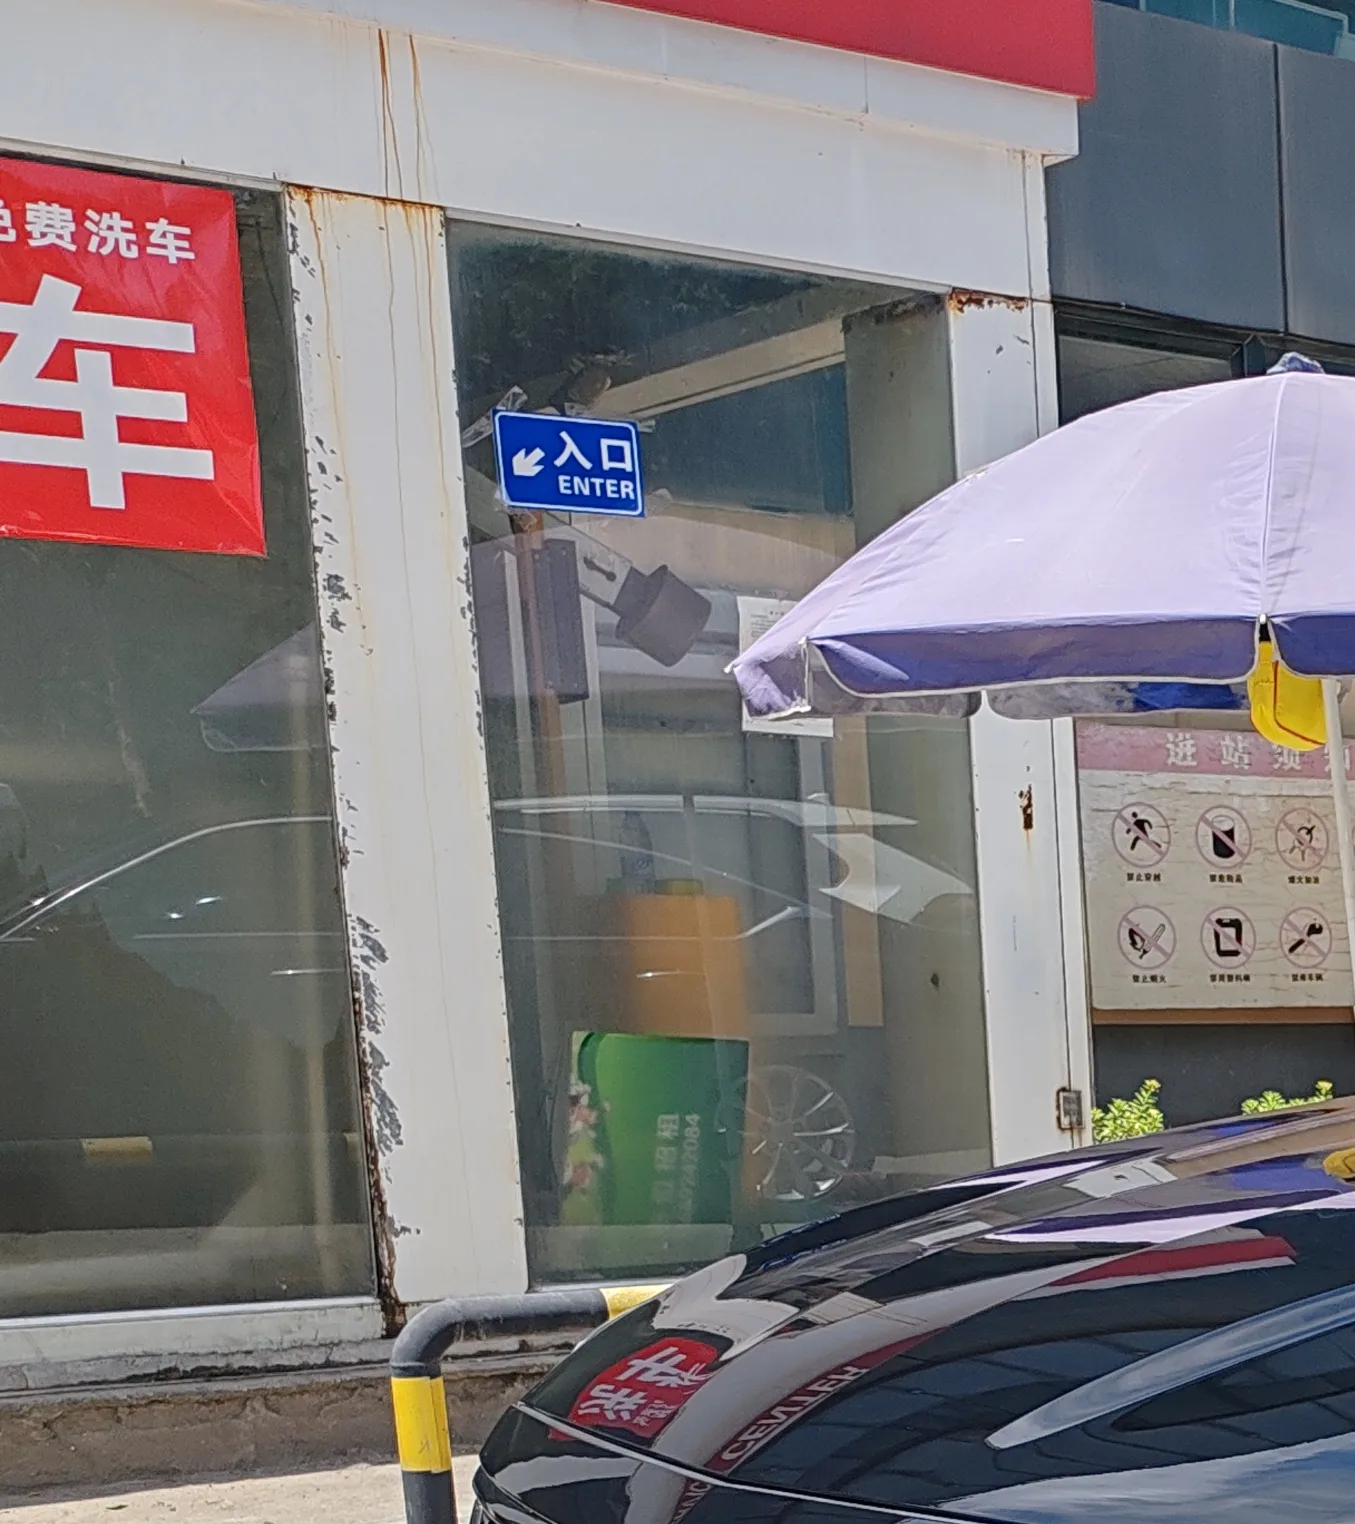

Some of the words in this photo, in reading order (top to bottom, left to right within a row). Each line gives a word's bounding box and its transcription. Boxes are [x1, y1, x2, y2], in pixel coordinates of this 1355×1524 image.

[0, 273, 214, 510] 车
[554, 430, 633, 472] 入口
[558, 475, 635, 500] ENTER
